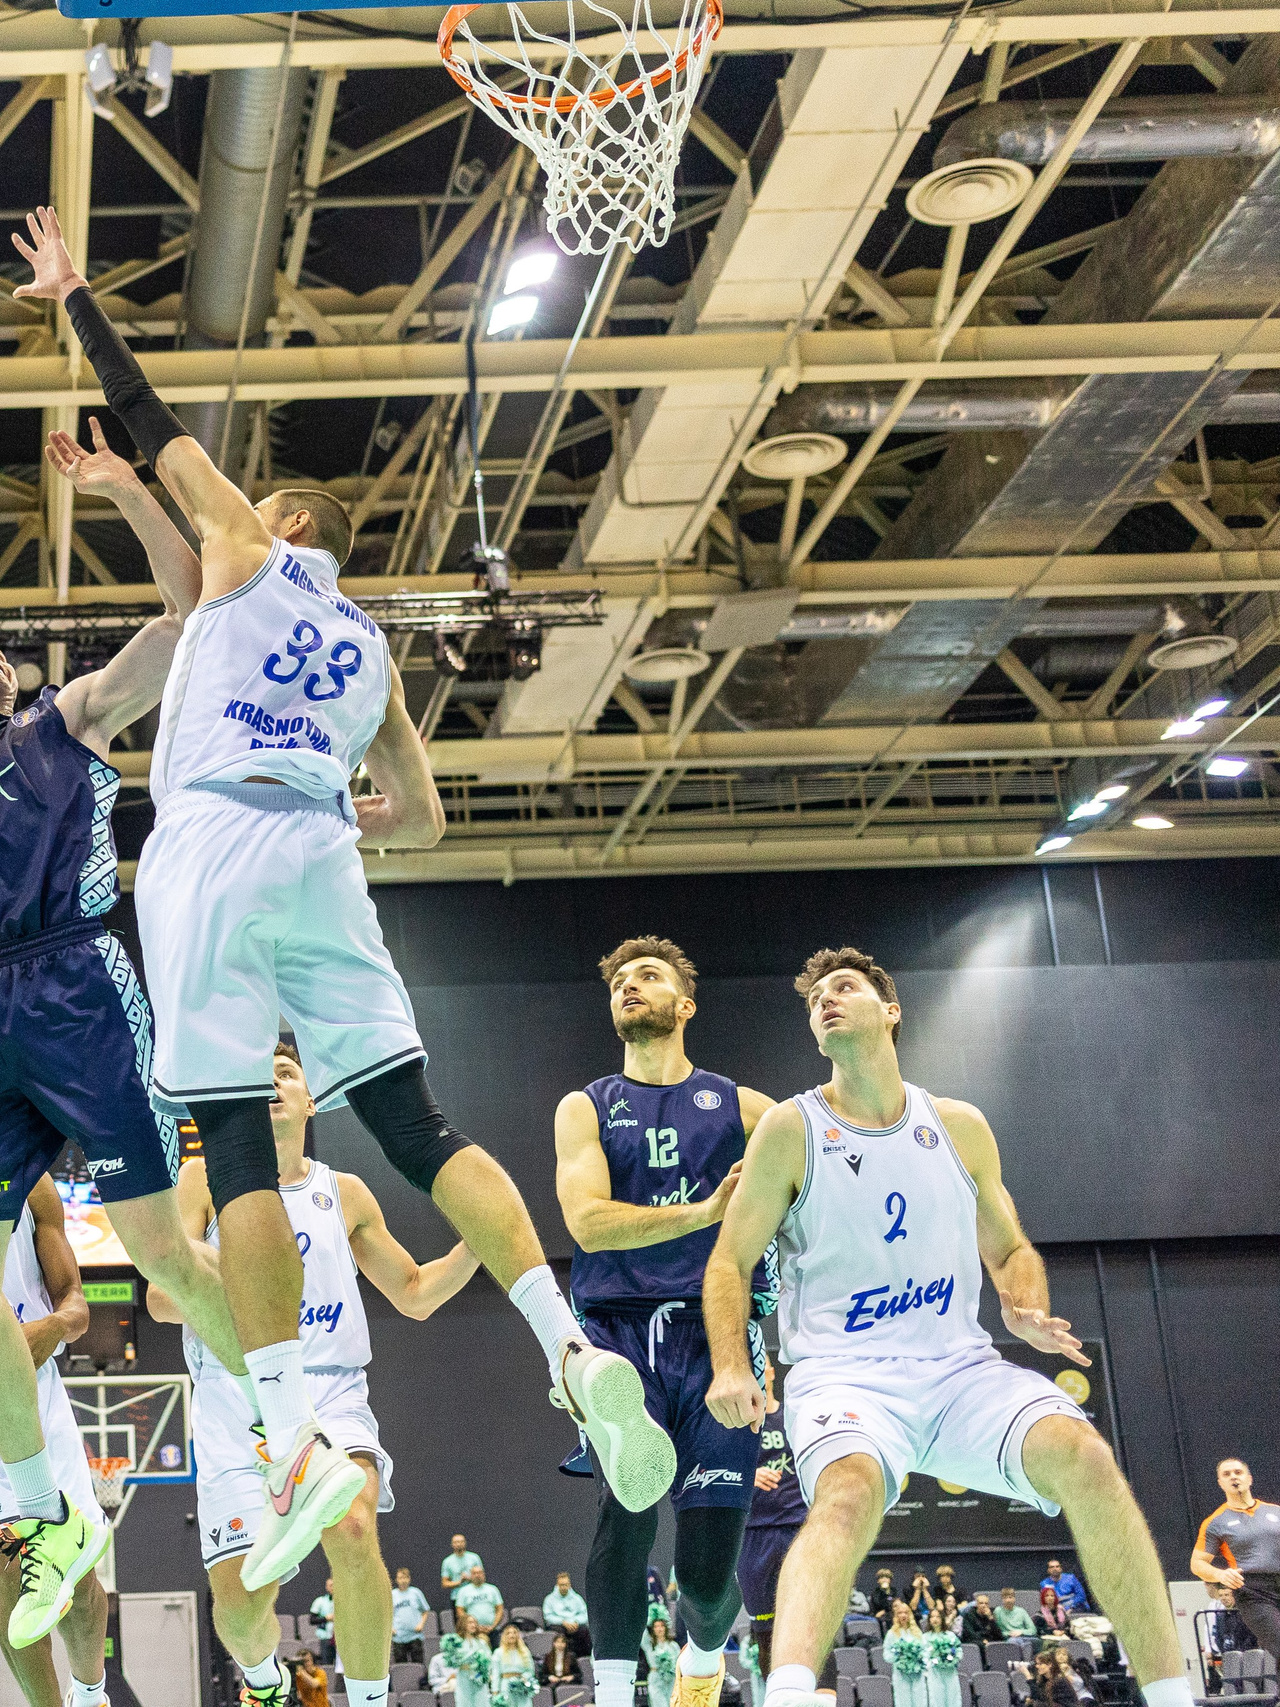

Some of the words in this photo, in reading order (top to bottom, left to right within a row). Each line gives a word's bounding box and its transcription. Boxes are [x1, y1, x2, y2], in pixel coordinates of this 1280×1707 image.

[263, 620, 362, 702] 33
[223, 699, 332, 755] KRASNOYAR
[645, 1127, 679, 1168] 12
[883, 1192, 908, 1243] 2
[298, 1300, 343, 1333] isey
[844, 1273, 954, 1333] Enisey
[761, 1430, 785, 1450] 38
[226, 1533, 249, 1543] ENISEY
